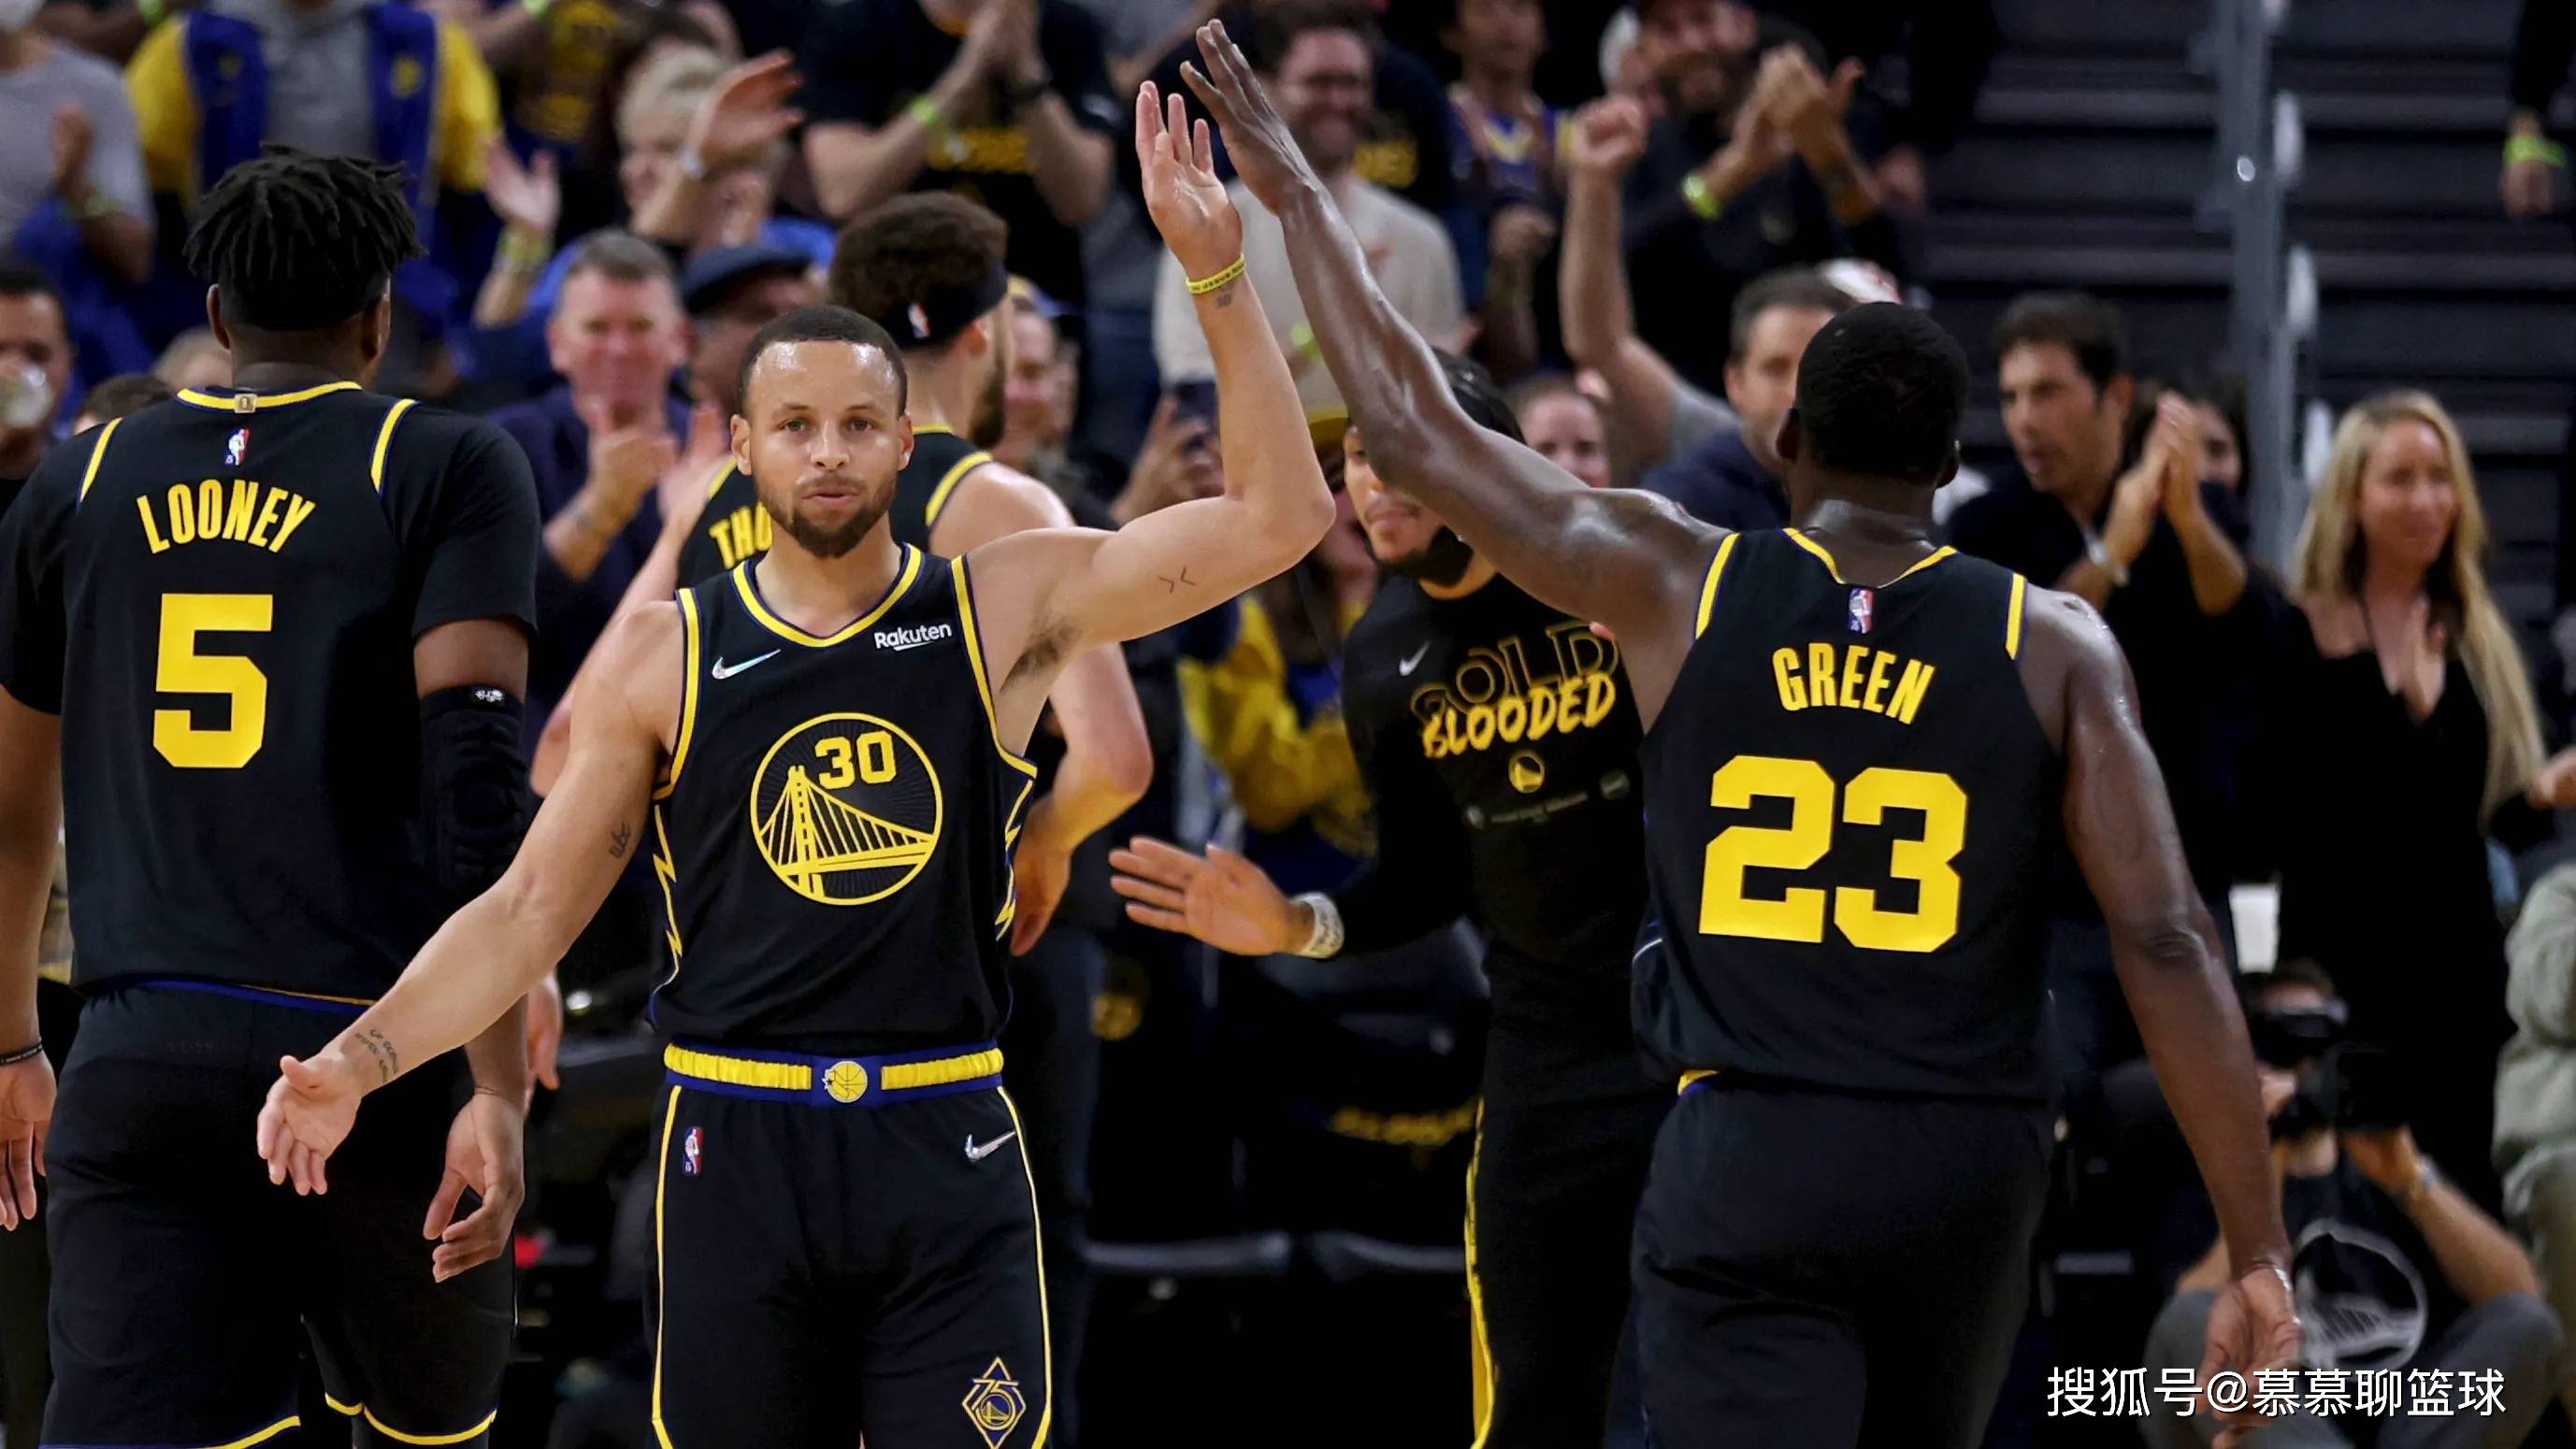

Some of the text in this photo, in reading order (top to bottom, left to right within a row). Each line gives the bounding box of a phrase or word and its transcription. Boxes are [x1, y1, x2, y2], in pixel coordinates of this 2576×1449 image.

[137, 478, 316, 554] LOONEY
[873, 623, 953, 650] Rakuten
[152, 593, 274, 768] 5
[1421, 671, 1617, 758] BLOODED
[1772, 642, 1936, 724] GREEN
[814, 729, 898, 790] 30
[1698, 754, 1967, 953] 23
